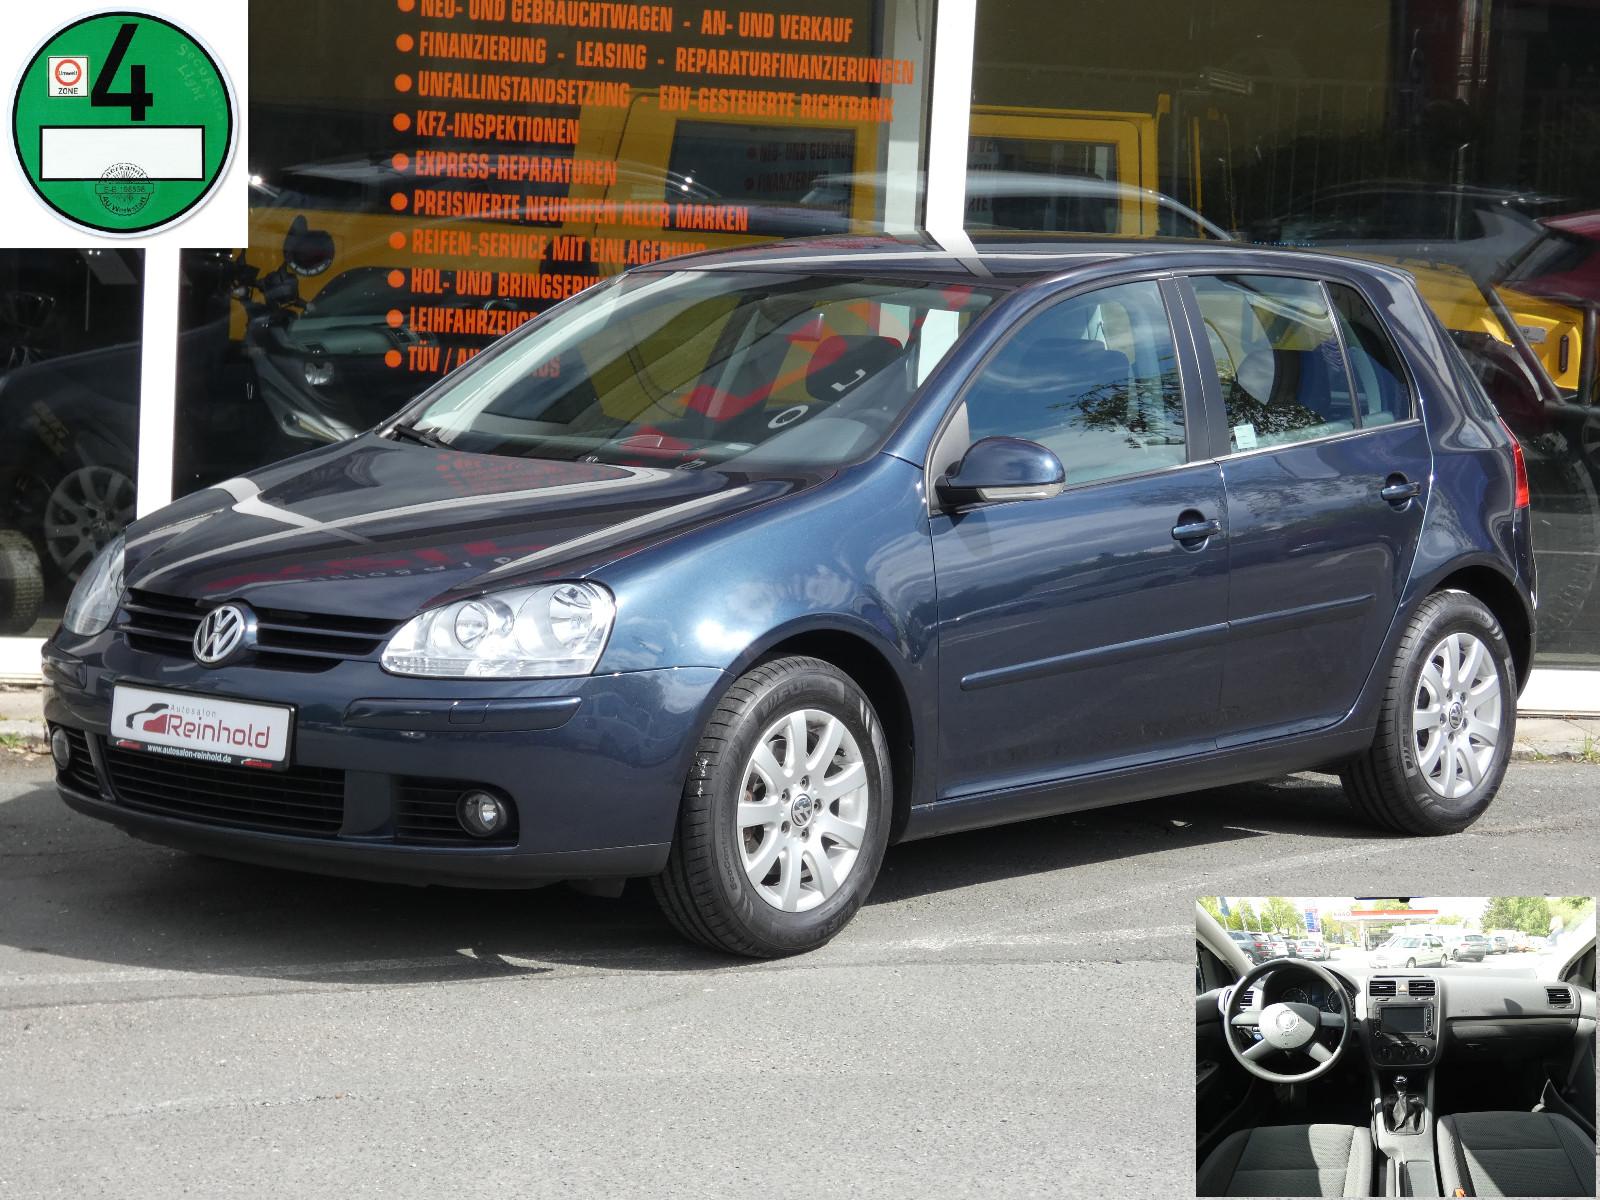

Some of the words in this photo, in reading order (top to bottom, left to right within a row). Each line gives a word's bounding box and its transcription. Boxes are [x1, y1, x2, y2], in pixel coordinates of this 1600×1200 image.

[421, 0, 463, 19] NEU-
[469, 0, 506, 21] UND
[511, 0, 673, 33] GEBRAUCHTWAGEN
[701, 9, 734, 36] AN-
[739, 11, 774, 38] UND
[780, 14, 854, 43] VERKAUF
[419, 31, 547, 64] FINANZIERUNG
[576, 40, 648, 70] LEASING
[675, 47, 915, 85] REPARATURFINANZIERUNGEN
[417, 71, 630, 108] UNFALLINSTANDSETZUNG
[658, 85, 796, 118] EDV-GESTEUERTE
[800, 93, 895, 123] RICHTBANK
[416, 110, 579, 144] KFZ-INSPEKTIONEN
[415, 151, 618, 186] EXPRESS-REPARATUREN
[413, 190, 520, 220] PREISWERTE
[525, 195, 617, 226] NEUREIFEN
[622, 200, 670, 228] ALLER
[675, 202, 749, 232] MARKEN
[411, 228, 547, 261] REIFEN-SERVICE
[552, 235, 587, 262] MIT
[411, 267, 450, 294] HOL-
[455, 270, 493, 297] UND
[408, 340, 440, 372] TÜV
[170, 704, 217, 719] Autosalon
[166, 714, 271, 749] Reinhold
[147, 744, 232, 764] www.autosalon-reinhold.de
